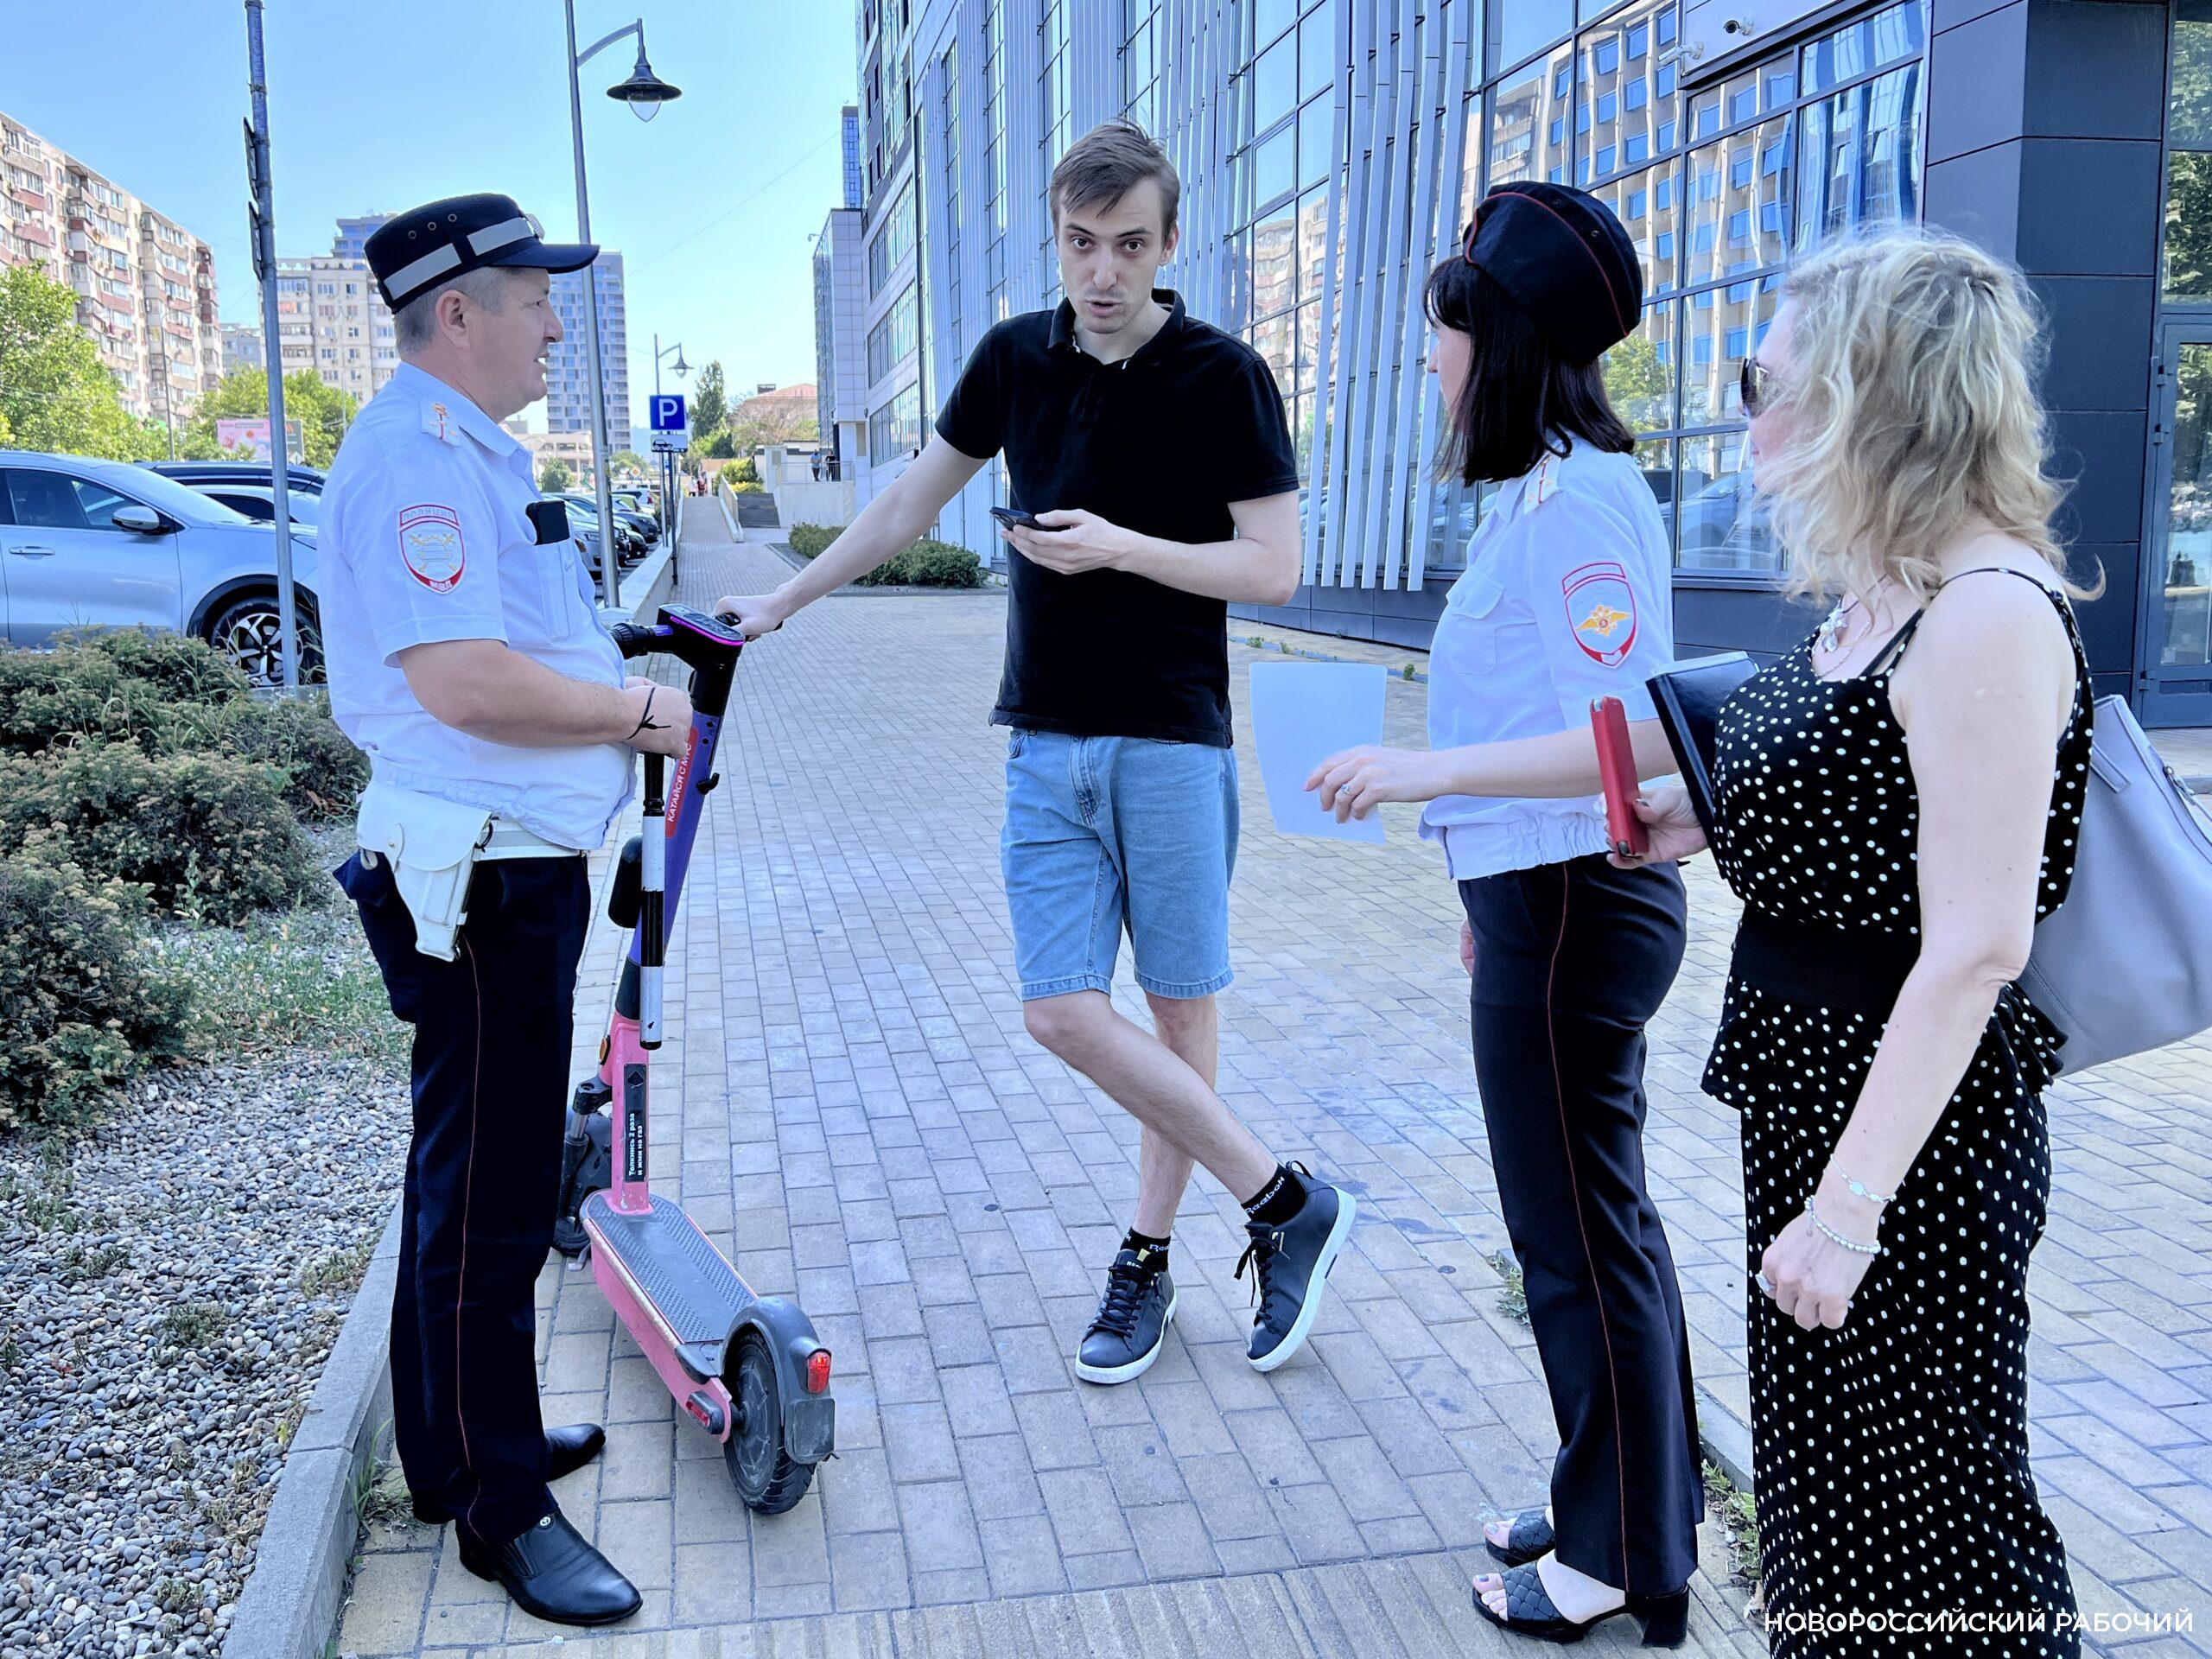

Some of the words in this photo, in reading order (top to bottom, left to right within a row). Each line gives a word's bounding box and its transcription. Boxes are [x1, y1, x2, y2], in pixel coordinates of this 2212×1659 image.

[658, 398, 678, 426] P
[430, 580, 452, 591] МВД
[667, 775, 684, 823] КАТАЙСЯ
[679, 766, 686, 775] С
[638, 1139, 643, 1149] на
[1245, 1176, 1285, 1214] Reebok
